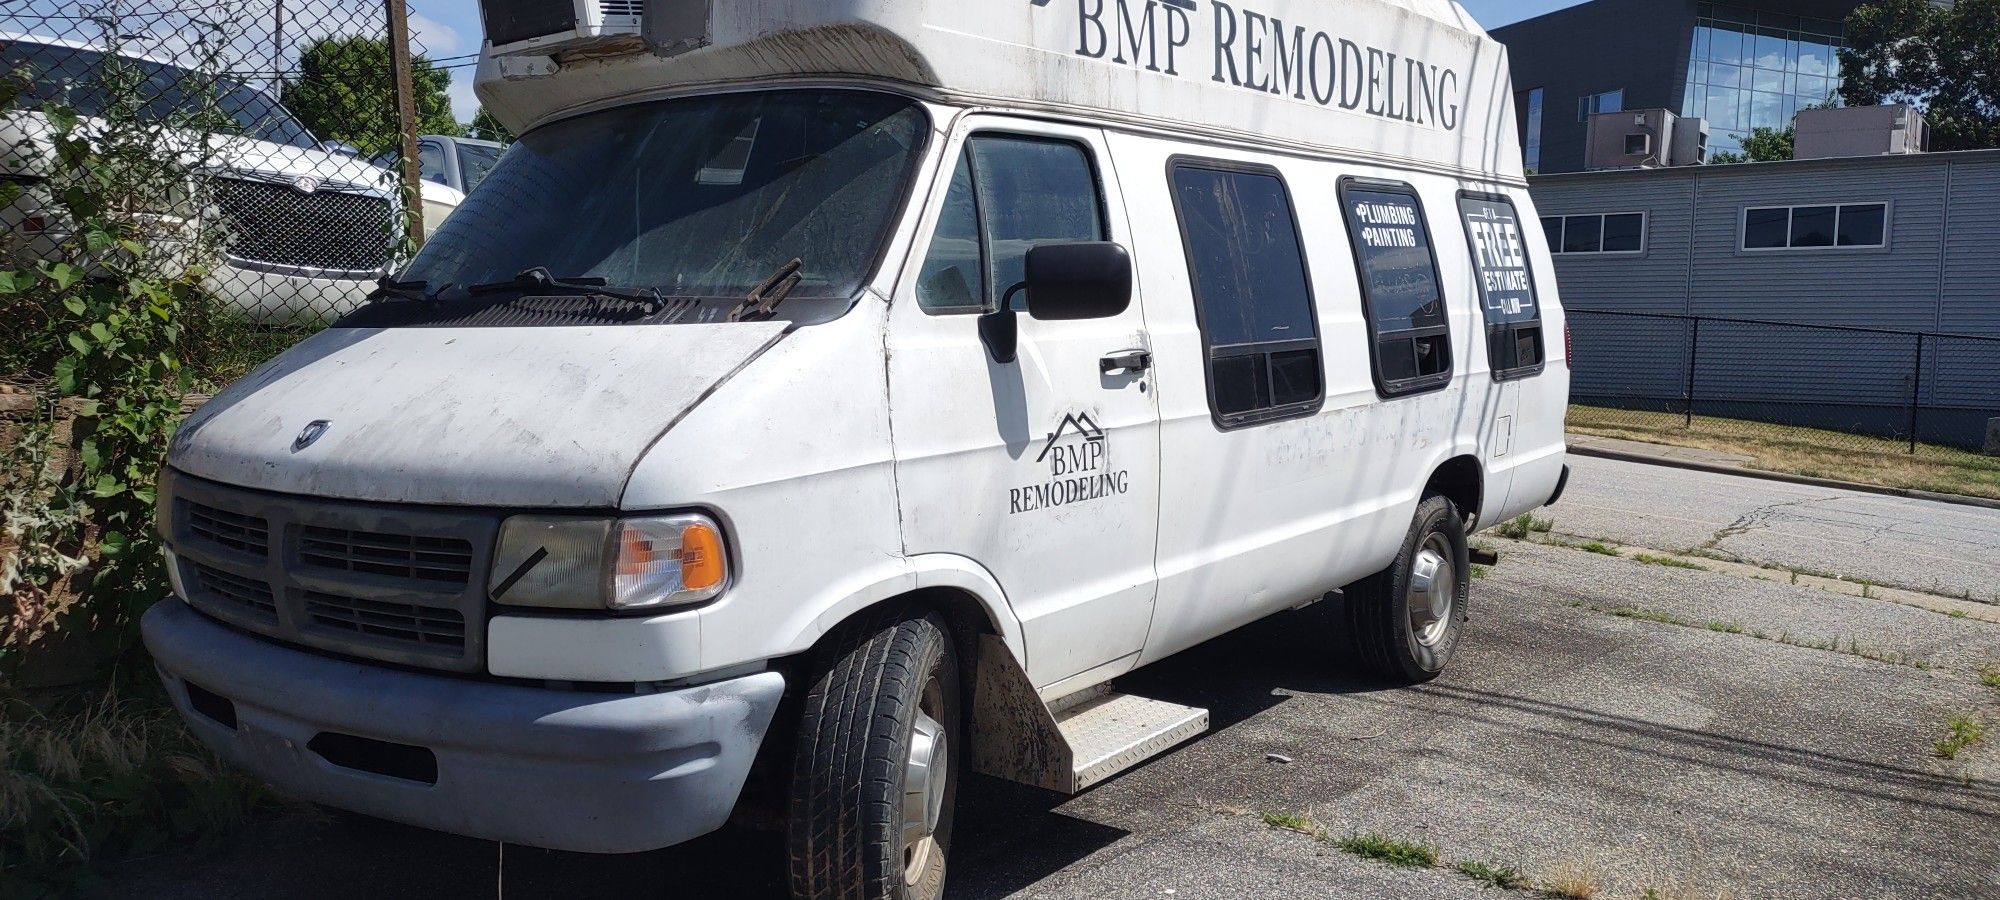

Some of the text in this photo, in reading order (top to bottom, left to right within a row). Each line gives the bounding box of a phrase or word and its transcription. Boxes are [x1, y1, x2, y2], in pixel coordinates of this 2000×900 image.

[1075, 0, 1457, 130] BMP REMODELING
[1470, 221, 1523, 267] FREE
[1484, 270, 1527, 292] ESTIMATE
[1052, 441, 1102, 476] BMP
[1010, 470, 1128, 514] REMODELING
